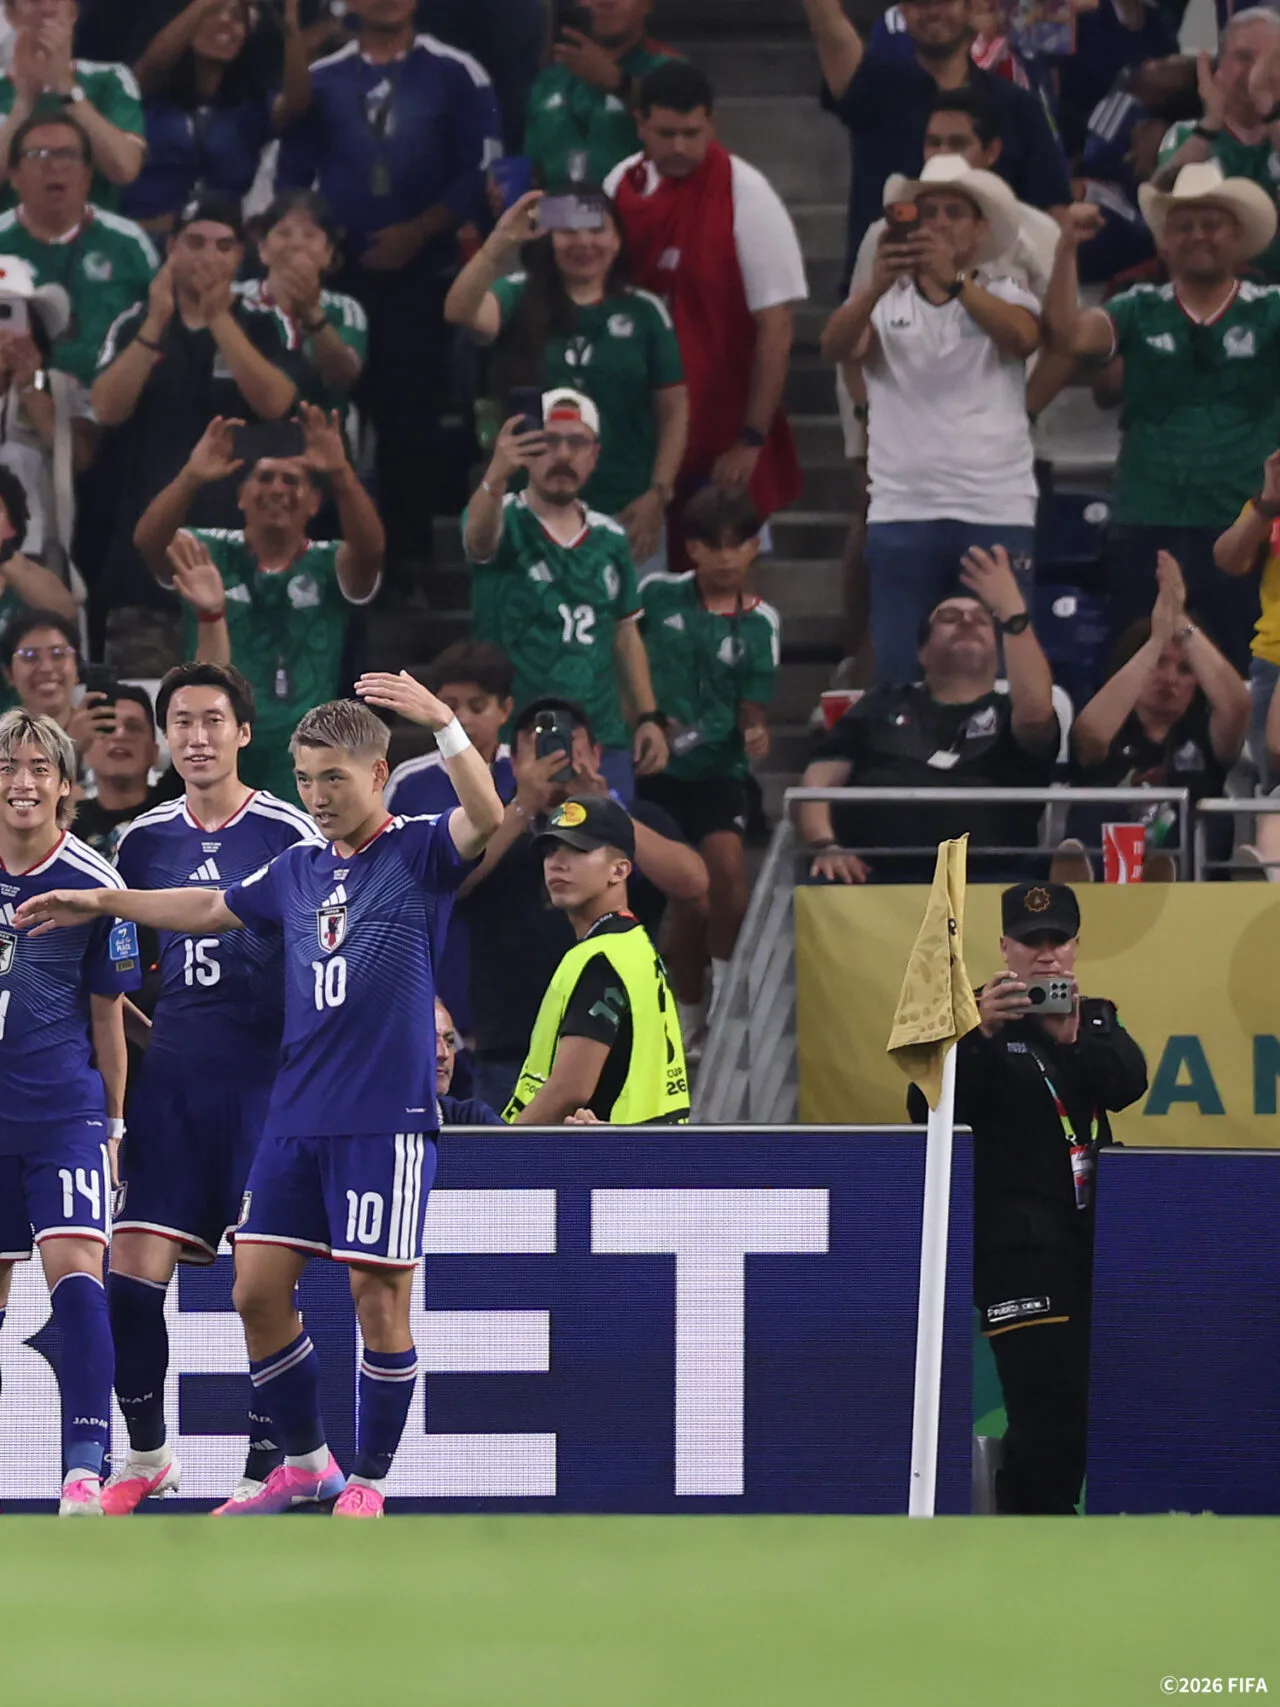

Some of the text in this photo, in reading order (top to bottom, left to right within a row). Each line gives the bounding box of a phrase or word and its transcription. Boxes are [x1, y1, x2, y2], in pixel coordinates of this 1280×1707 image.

[558, 603, 595, 645] 12
[184, 939, 220, 986] 15
[311, 956, 347, 1010] 10
[666, 1079, 687, 1096] 26
[667, 1067, 682, 1078] CUP
[58, 1168, 100, 1221] 14
[346, 1189, 384, 1244] 10
